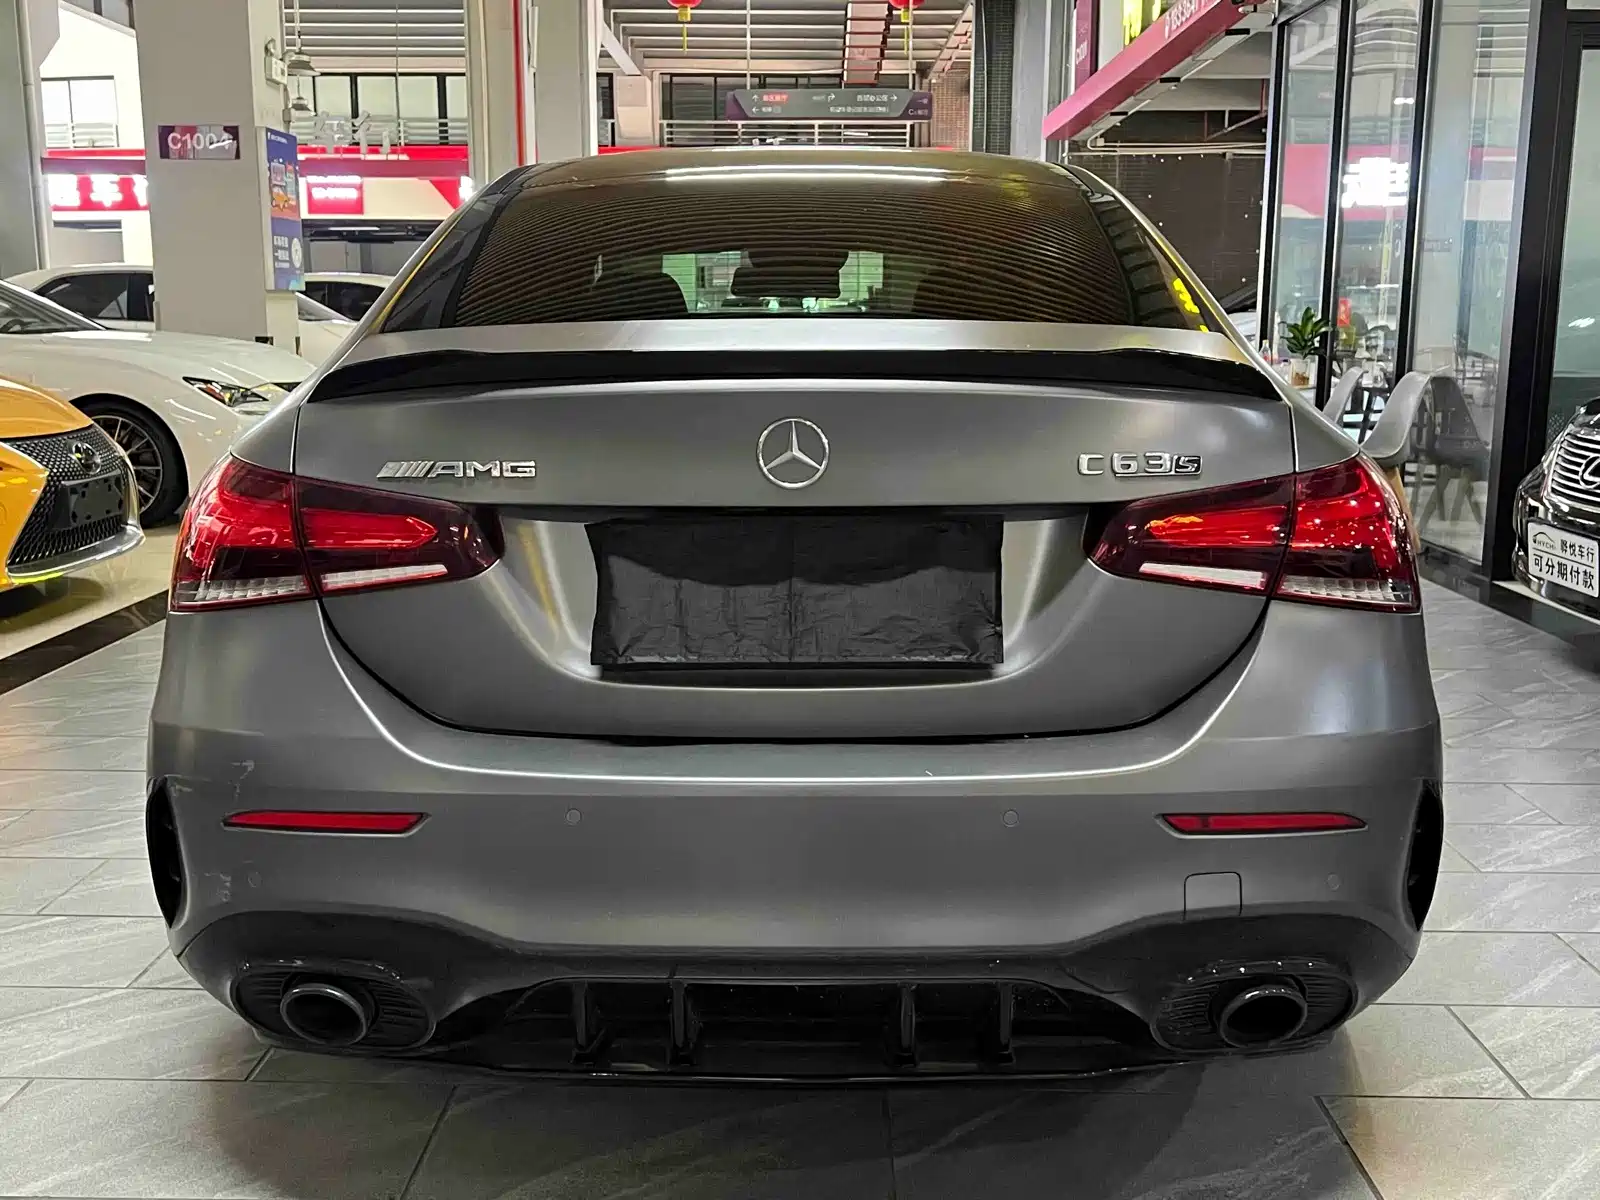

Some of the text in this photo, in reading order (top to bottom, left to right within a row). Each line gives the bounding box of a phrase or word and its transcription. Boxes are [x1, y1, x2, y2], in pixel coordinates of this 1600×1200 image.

[427, 460, 536, 478] AMG
[1533, 553, 1595, 591] 可分期付款
